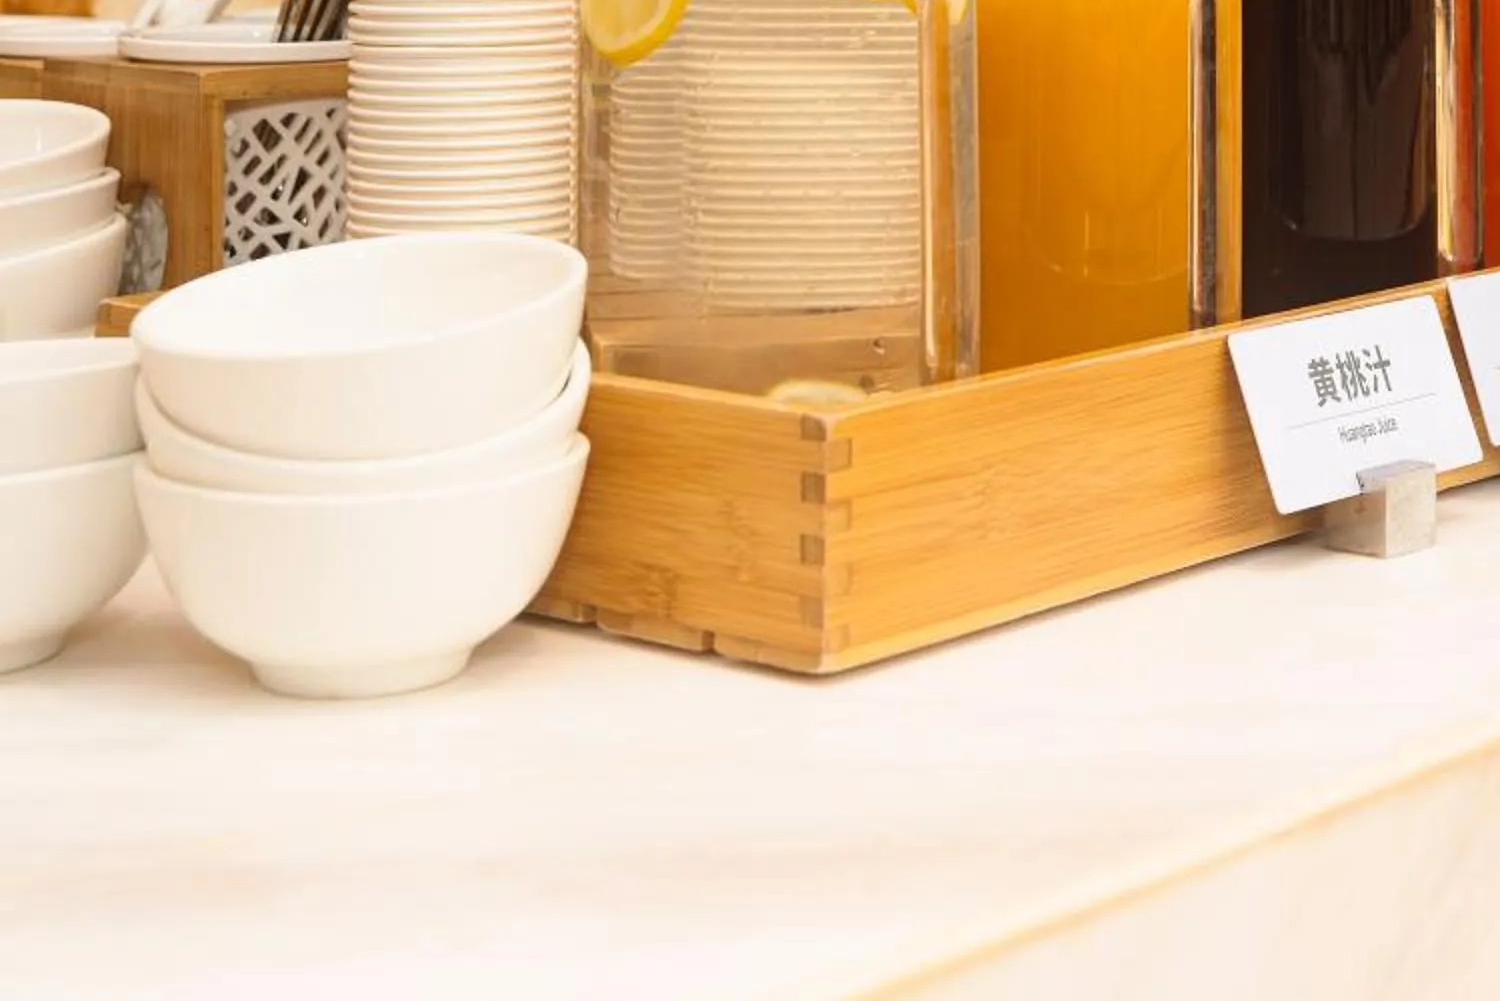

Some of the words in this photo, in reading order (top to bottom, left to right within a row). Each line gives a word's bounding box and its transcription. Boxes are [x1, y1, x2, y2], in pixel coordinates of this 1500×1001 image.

[1307, 344, 1393, 408] 黄桃汁
[1378, 415, 1399, 436] Juice
